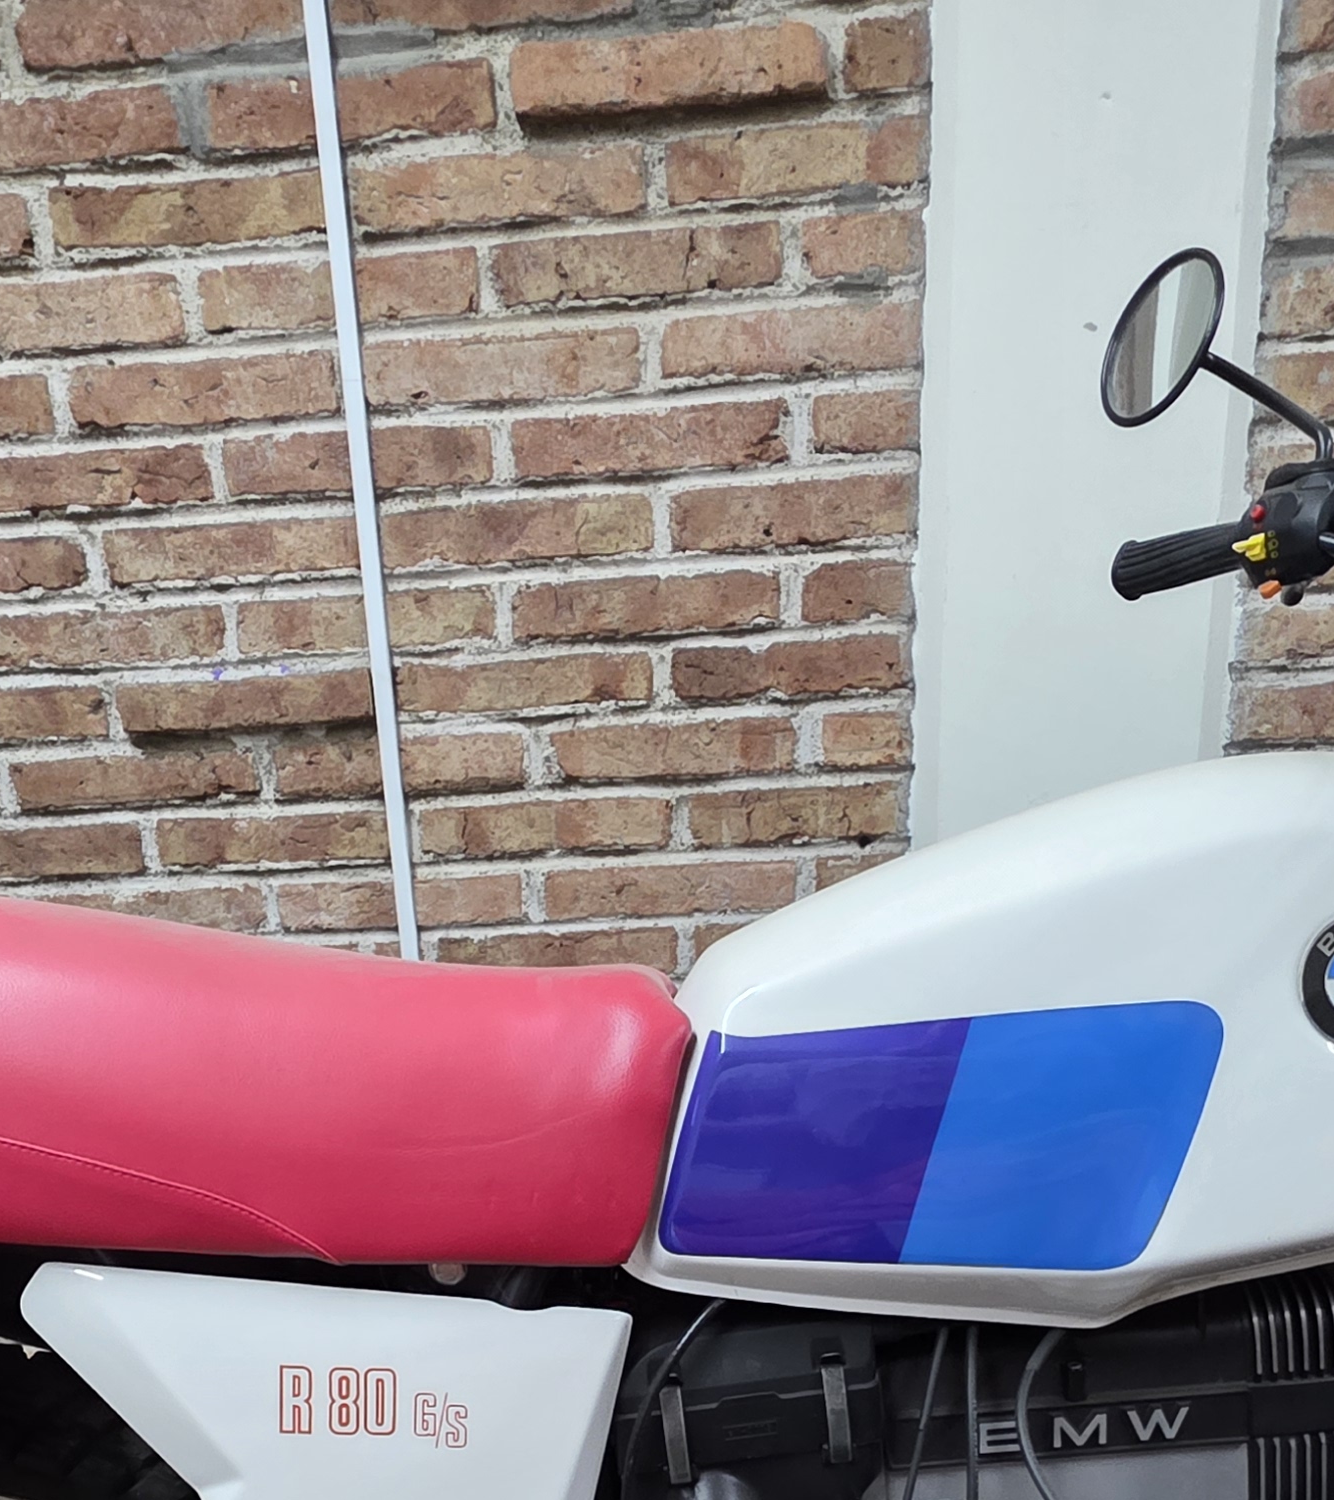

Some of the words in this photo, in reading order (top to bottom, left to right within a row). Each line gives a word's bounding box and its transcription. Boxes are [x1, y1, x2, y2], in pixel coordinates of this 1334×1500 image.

[279, 1364, 313, 1435] R
[328, 1366, 397, 1436] 80
[413, 1392, 469, 1449] G/S
